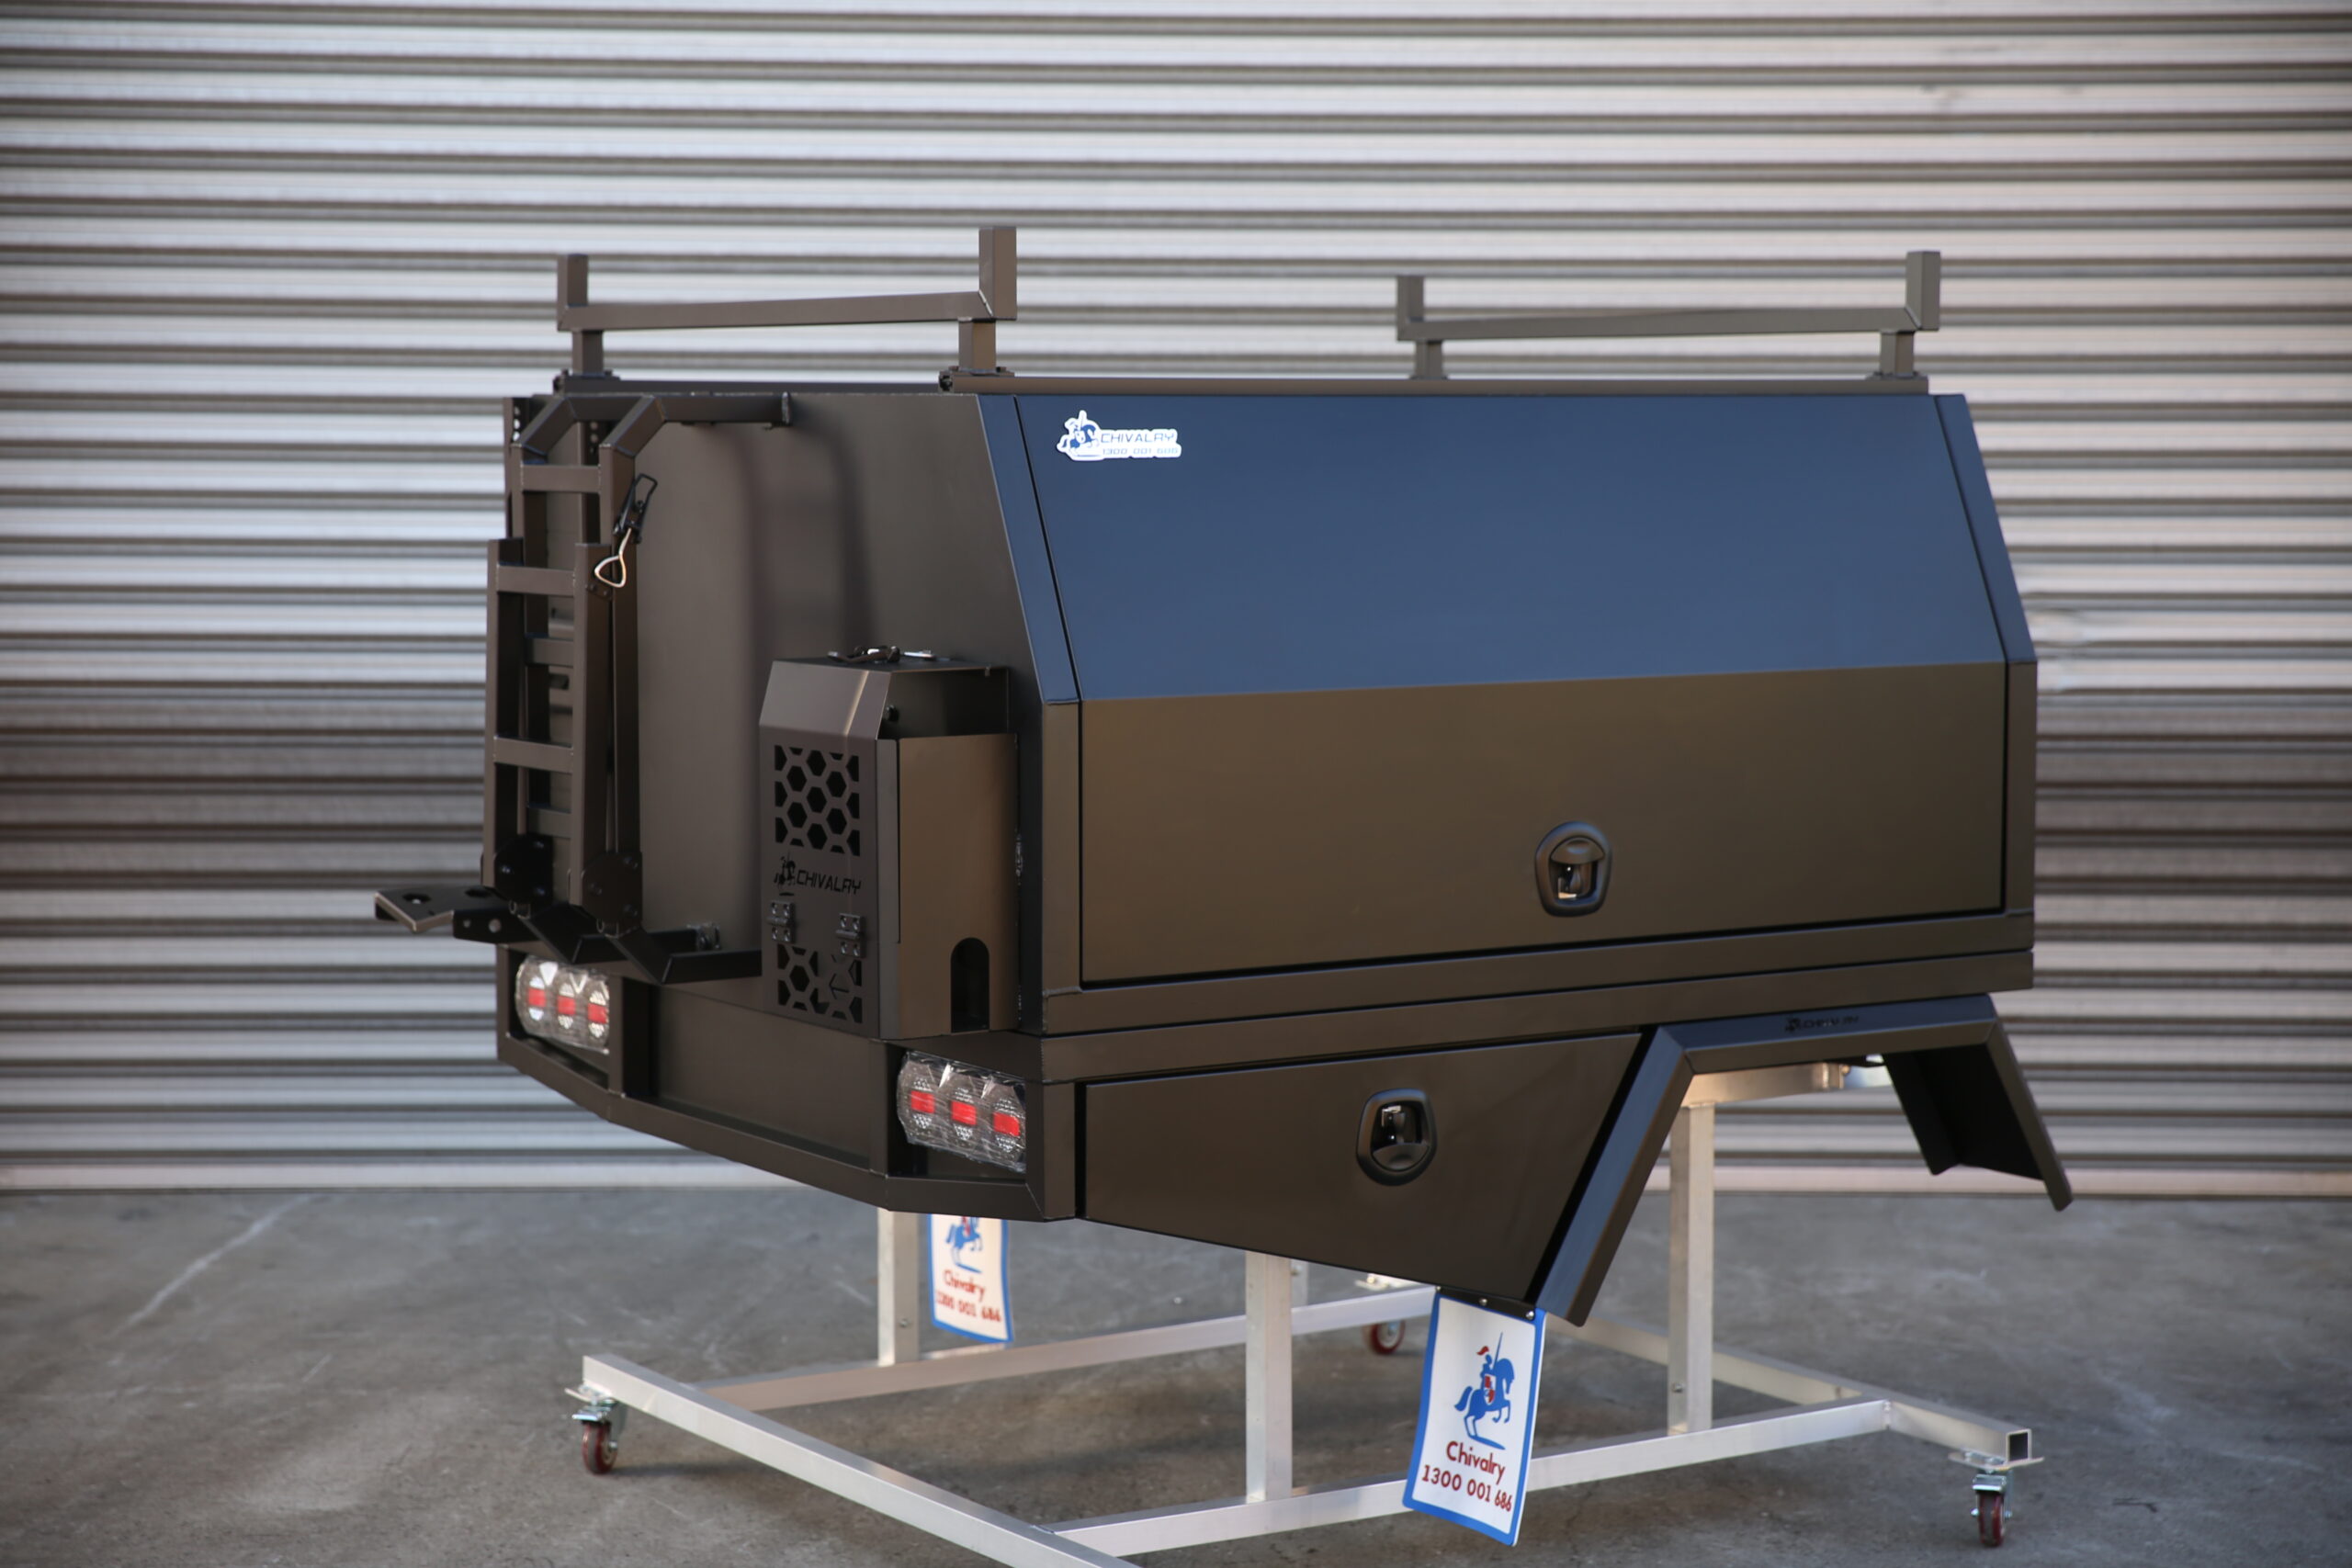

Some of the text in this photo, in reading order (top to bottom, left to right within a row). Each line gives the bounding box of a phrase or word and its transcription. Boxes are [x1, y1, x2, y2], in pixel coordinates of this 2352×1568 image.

[1101, 433, 1175, 444] CHIVALRY
[797, 869, 863, 896] CHIVALRY
[1446, 1440, 1506, 1485] Chivalry
[1421, 1464, 1512, 1513] 1300 001 686
